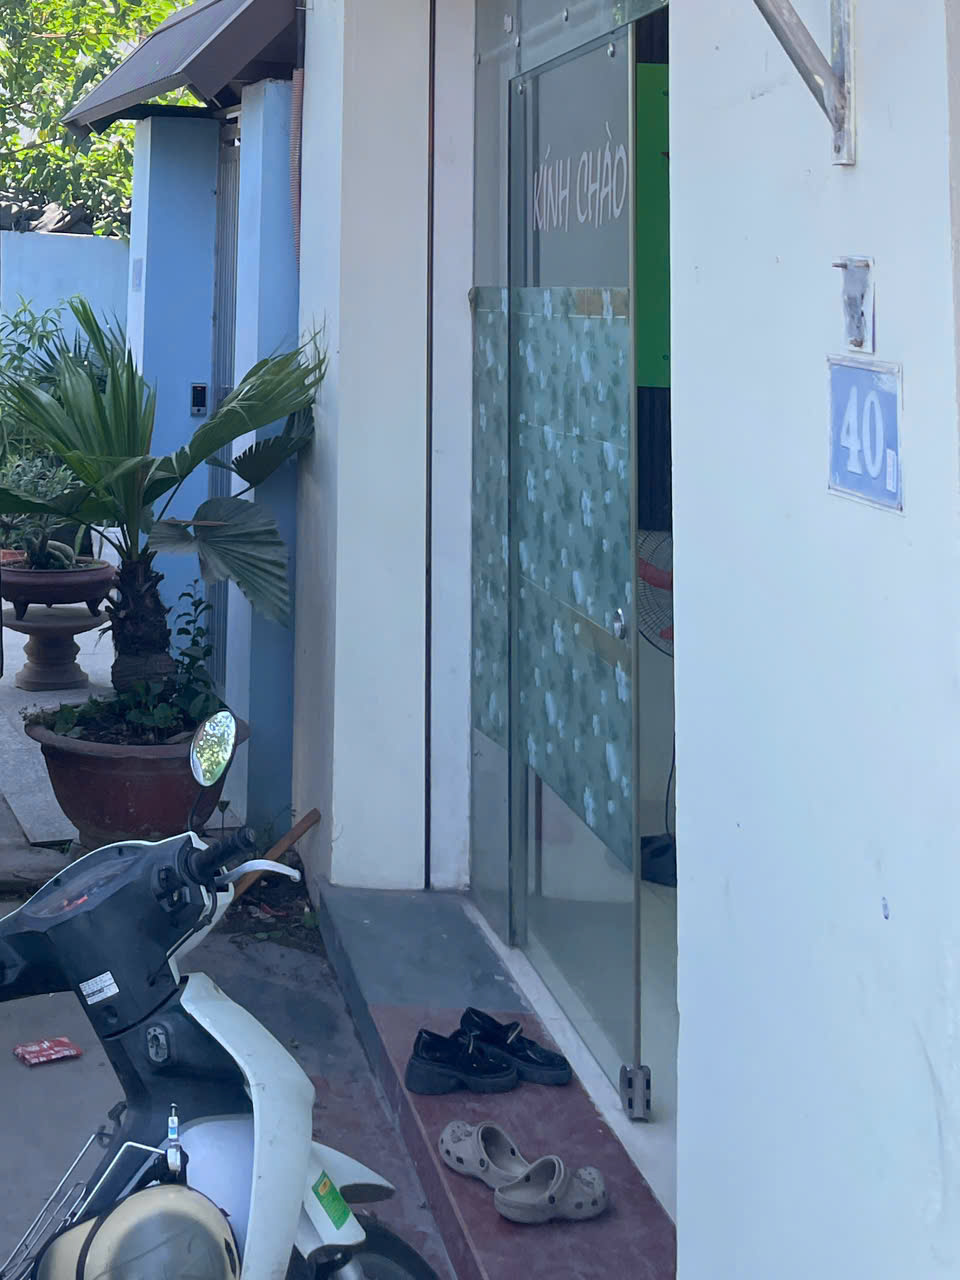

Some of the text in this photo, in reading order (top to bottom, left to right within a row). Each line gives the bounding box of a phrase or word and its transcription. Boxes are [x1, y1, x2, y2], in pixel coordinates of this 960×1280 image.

[533, 121, 627, 232] KÍNH CHÀO
[840, 385, 885, 479] 40
